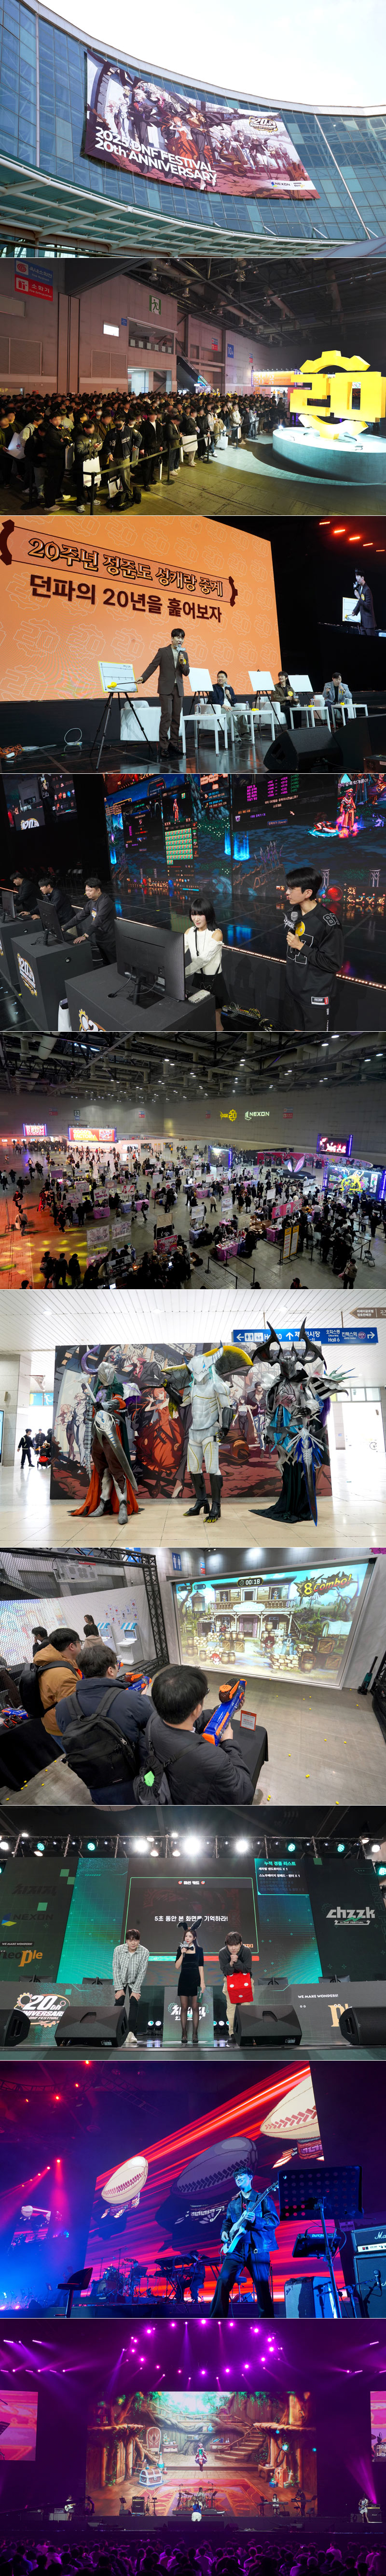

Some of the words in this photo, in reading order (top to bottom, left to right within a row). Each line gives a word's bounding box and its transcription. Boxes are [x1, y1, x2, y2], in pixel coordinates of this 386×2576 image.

[95, 138, 126, 157] 20th
[128, 150, 217, 184] ANNIVERSARY
[96, 127, 130, 145] 2025
[131, 138, 160, 158] DNF
[160, 149, 216, 173] FESTIVAL
[28, 538, 99, 572] 20주년
[199, 576, 223, 598] 중계
[30, 574, 95, 604] 던파의
[103, 588, 162, 614] 20년을
[167, 598, 221, 623] 훑어보자
[304, 1582, 313, 1595] 8
[326, 1907, 375, 1918] chzzk
[22, 1995, 62, 2010] 20th
